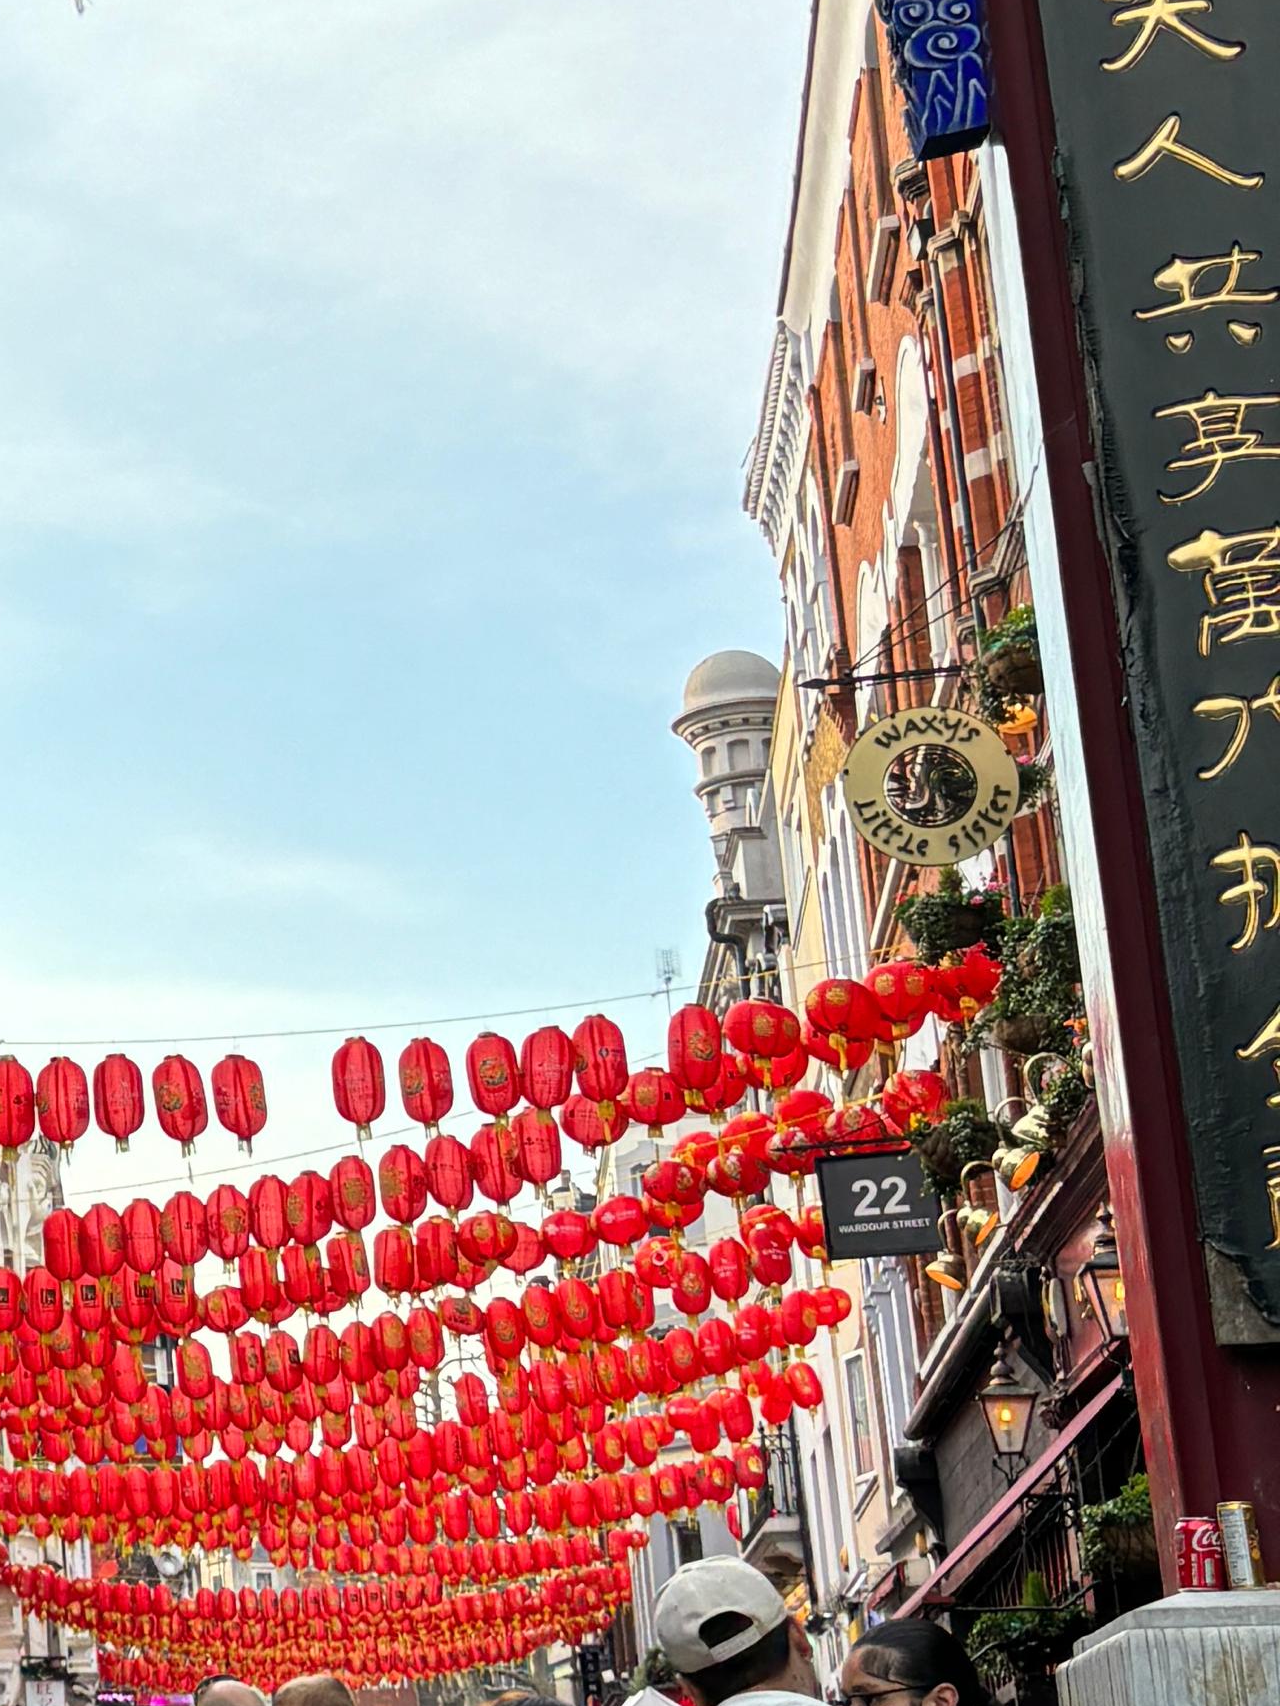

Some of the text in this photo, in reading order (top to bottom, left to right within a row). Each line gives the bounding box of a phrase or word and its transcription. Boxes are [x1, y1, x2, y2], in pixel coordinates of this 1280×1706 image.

[874, 714, 981, 750] WAXY'S
[851, 1176, 911, 1216] 22
[838, 1217, 931, 1233] WARDOUR STREET
